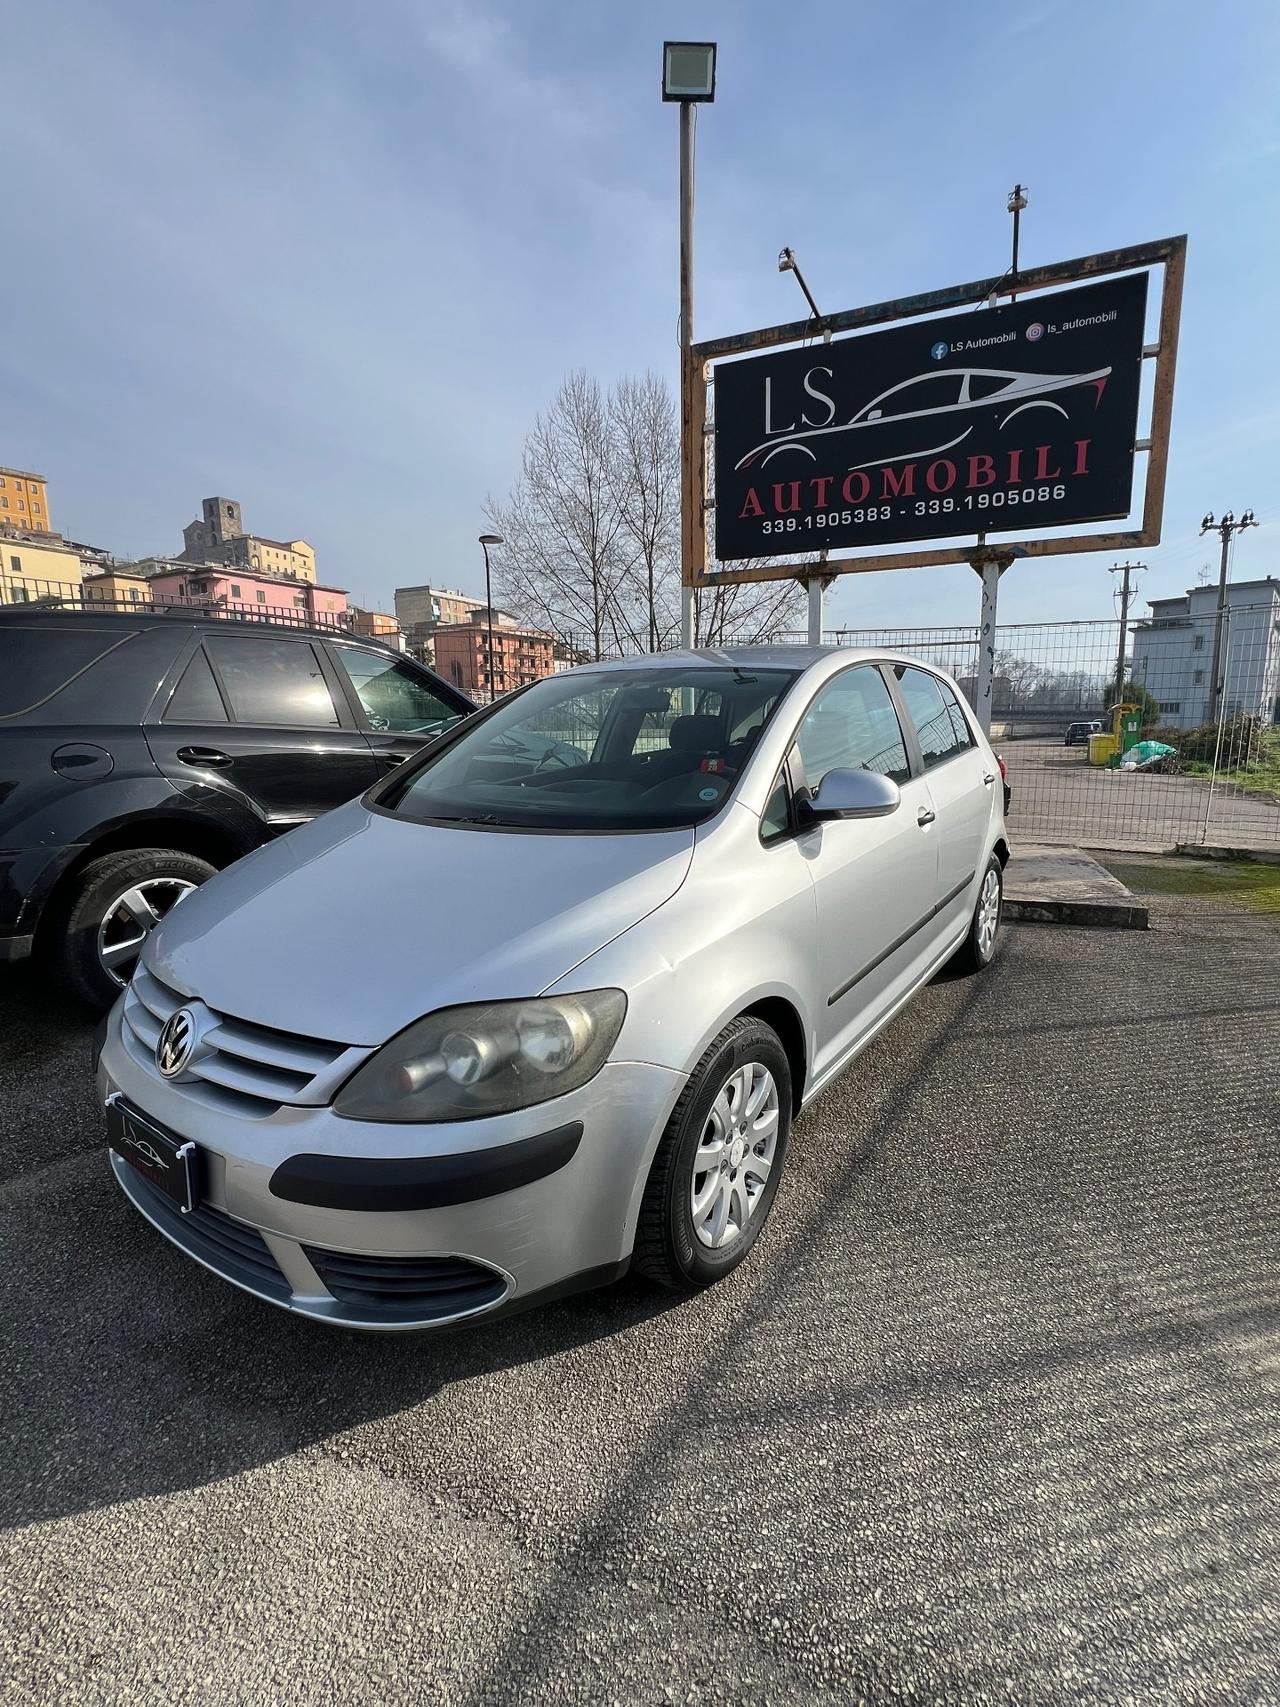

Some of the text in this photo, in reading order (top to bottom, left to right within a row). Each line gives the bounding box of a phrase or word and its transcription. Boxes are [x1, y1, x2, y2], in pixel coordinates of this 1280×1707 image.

[950, 341, 964, 354] LS
[965, 331, 1017, 350] Automobili
[1047, 310, 1118, 337] ls_automobili
[737, 439, 1092, 518] AUTOMOBILI
[762, 506, 891, 535] 339.1905383
[914, 484, 1066, 516] 339.1905086
